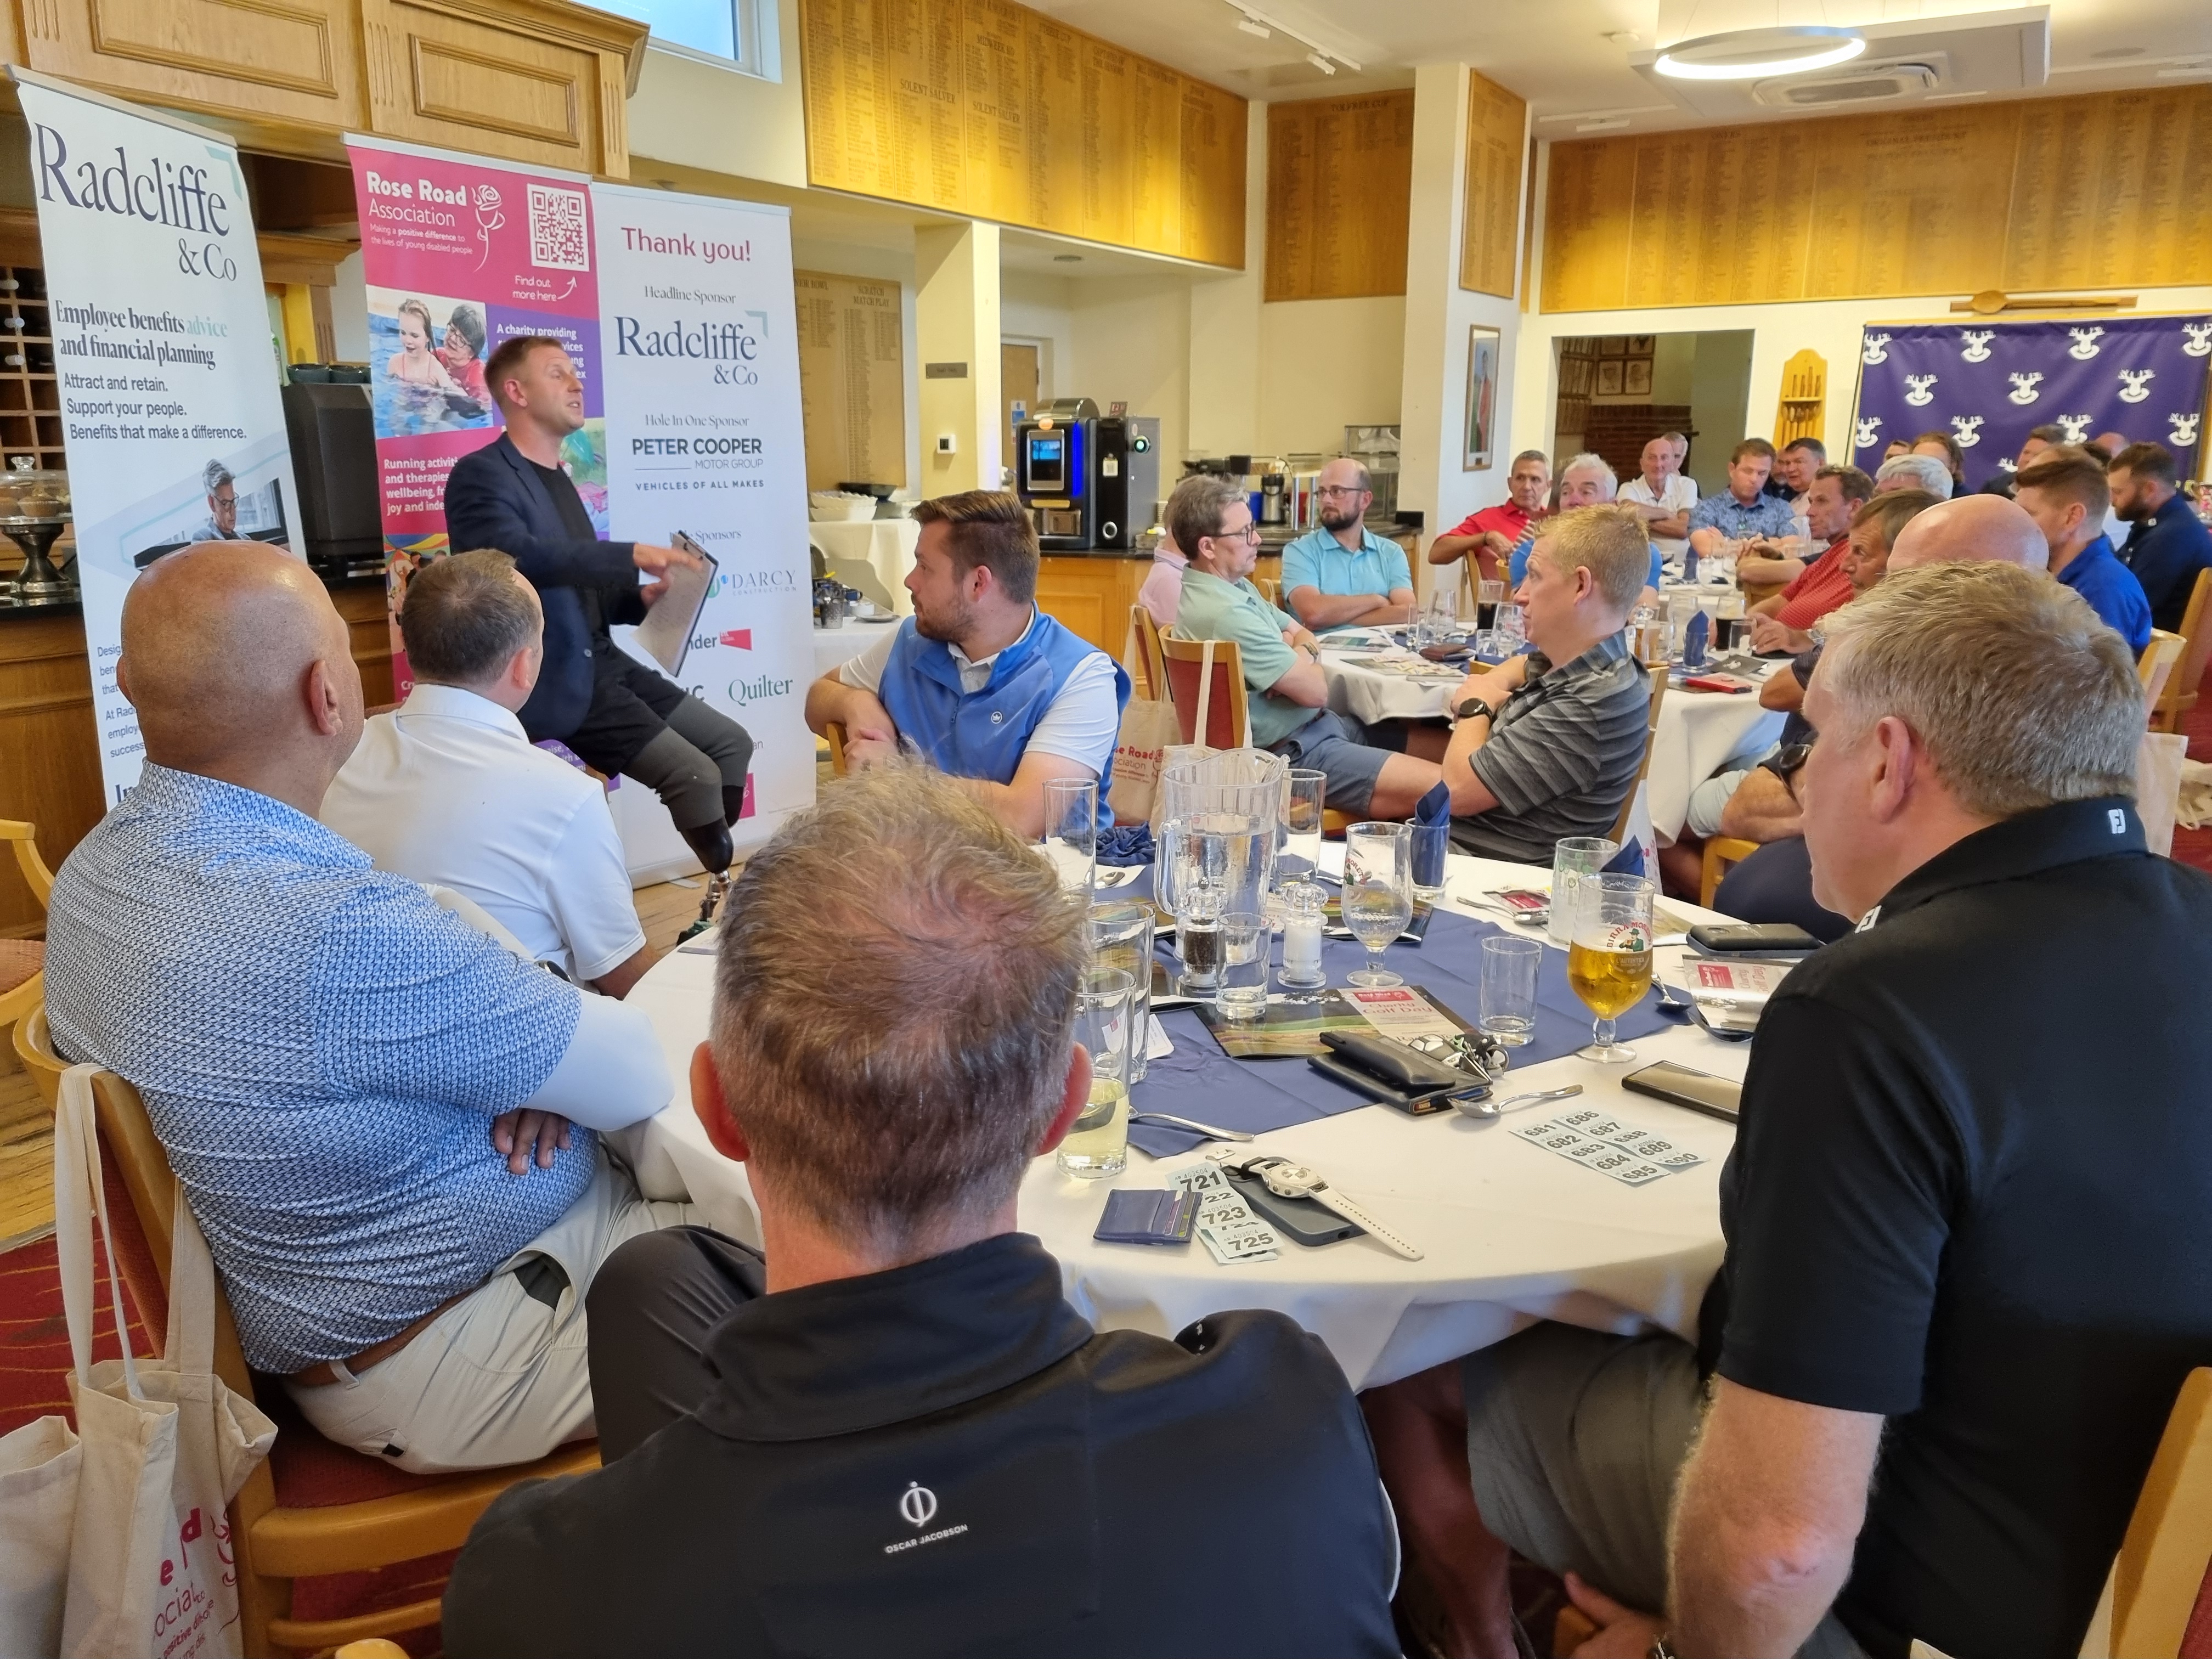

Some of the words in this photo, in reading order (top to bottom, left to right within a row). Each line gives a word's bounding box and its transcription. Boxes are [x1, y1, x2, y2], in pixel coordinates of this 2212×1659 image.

[900, 78, 928, 97] SOLENT
[35, 122, 229, 236] Radcliffe
[366, 171, 413, 199] Rose
[419, 179, 467, 206] Road
[368, 198, 455, 227] Association
[370, 223, 391, 236] Making
[398, 228, 424, 237] positive
[425, 230, 456, 241] difference
[621, 227, 696, 257] Thank
[703, 240, 751, 264] you!
[178, 238, 201, 275] &
[204, 244, 236, 281] Co
[515, 274, 534, 286] Find
[535, 279, 551, 287] out
[795, 278, 810, 288] NIOR
[512, 291, 535, 300] more
[537, 290, 557, 301] here
[644, 285, 692, 302] Headline
[694, 289, 736, 305] Sponsor
[55, 300, 126, 332] Employee
[128, 307, 185, 334] benefits
[187, 315, 228, 337] advice
[496, 323, 504, 334] A
[505, 323, 535, 336] charity
[537, 327, 577, 340] providing
[614, 316, 757, 360] Radcliffe
[60, 334, 88, 356] and
[90, 334, 155, 360] financial
[157, 341, 216, 370] planning
[562, 341, 584, 351] vices
[64, 373, 105, 390] Attract
[107, 375, 127, 390] and
[131, 377, 168, 392] retain.
[714, 364, 730, 385] &
[733, 365, 758, 386] Co
[67, 398, 112, 417] Support
[115, 401, 143, 418] your
[146, 401, 187, 419] people.
[645, 415, 670, 426] Hole
[673, 415, 684, 426] In
[686, 416, 707, 426] One
[709, 416, 749, 430] Sponsor
[70, 424, 118, 439] Benefits
[120, 424, 145, 439] that
[148, 424, 179, 439] make
[182, 429, 189, 439] a
[191, 425, 247, 439] difference.
[632, 439, 689, 455] PETER
[693, 438, 762, 455] COOPER
[384, 458, 426, 471] Running
[695, 460, 729, 469] MOTOR
[731, 459, 763, 469] GROUP
[385, 473, 403, 484] and
[406, 472, 449, 484] therapies
[636, 481, 689, 491] VEHICLES
[693, 481, 706, 490] OF
[710, 481, 729, 489] ALL
[732, 479, 764, 488] MAKES
[386, 487, 435, 499] wellbeing,
[387, 503, 402, 516] joy
[404, 501, 424, 512] and
[426, 500, 445, 511] inde
[695, 530, 741, 544] Sponsors
[731, 570, 795, 589] DARCY
[732, 586, 797, 596] CONSTRUCTION
[97, 644, 121, 657] Desig
[100, 666, 116, 676] ben
[728, 674, 793, 707] Quilter
[106, 710, 115, 720] At
[116, 707, 138, 719] Rad
[108, 725, 142, 739] employ
[110, 742, 145, 758] success
[1128, 745, 1154, 760] Road
[2108, 808, 2126, 834] FJ
[1606, 924, 1629, 947] BIRRA
[1566, 1111, 1600, 1125] 686
[1524, 1125, 1557, 1136] 681
[1589, 1121, 1622, 1136] 687
[1547, 1135, 1582, 1148] 682
[1613, 1131, 1648, 1142] 688
[1571, 1144, 1606, 1156] 683
[1638, 1141, 1673, 1155] 689
[1596, 1154, 1632, 1170] 684
[1664, 1153, 1699, 1164] 690
[1622, 1166, 1658, 1179] 685
[1180, 1171, 1221, 1193] 721
[1205, 1192, 1234, 1204] 22
[1202, 1206, 1246, 1224] 723
[1228, 1233, 1274, 1251] 725
[884, 1538, 918, 1554] OSCAR
[918, 1523, 969, 1544] JACOBSON
